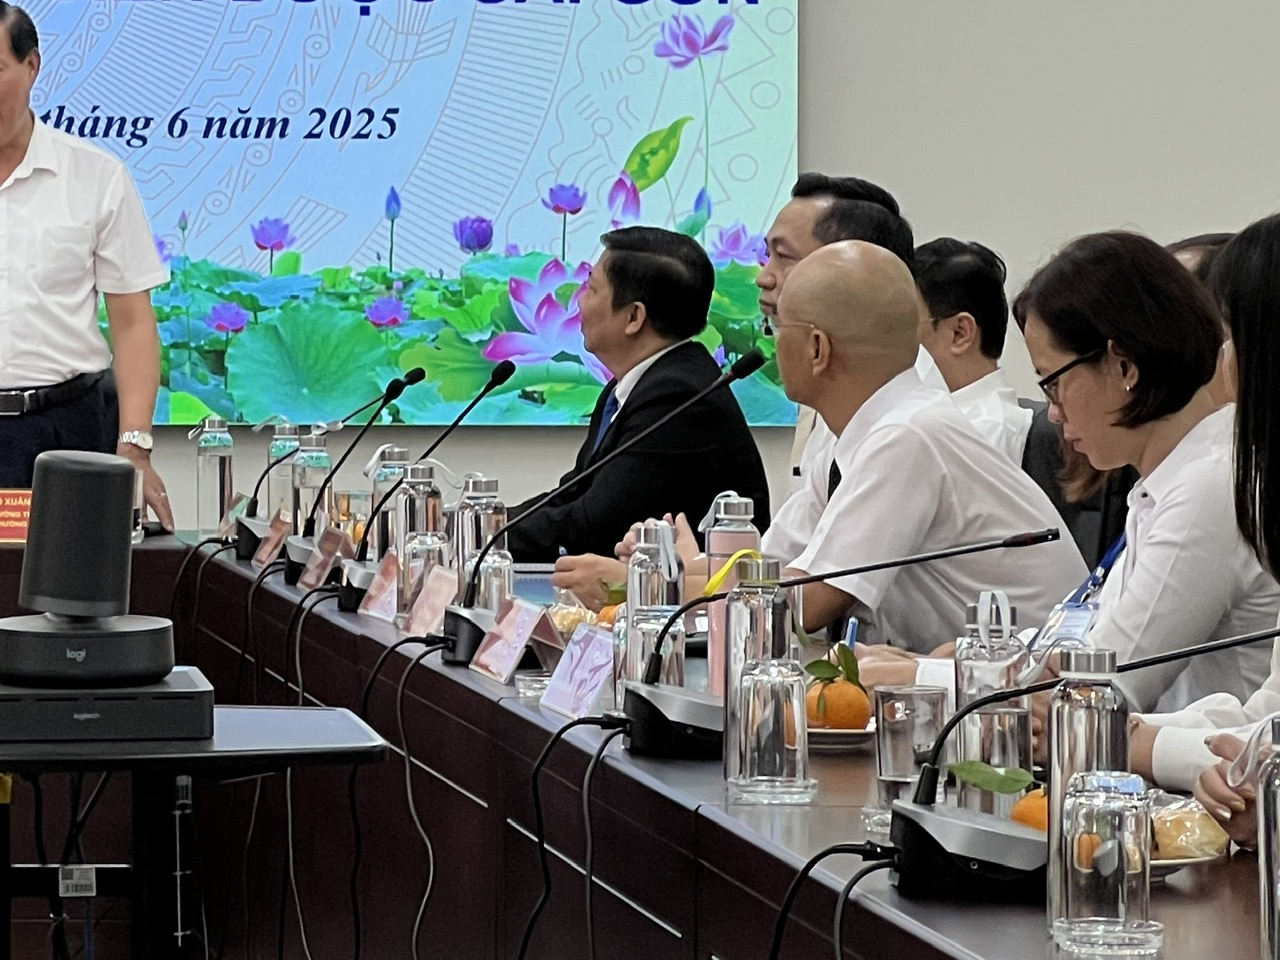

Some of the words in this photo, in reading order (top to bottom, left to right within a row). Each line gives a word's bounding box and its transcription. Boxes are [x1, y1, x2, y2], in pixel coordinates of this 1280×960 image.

[167, 107, 189, 139] 6
[202, 107, 291, 140] năm
[302, 107, 400, 140] 2025
[66, 648, 86, 662] logi
